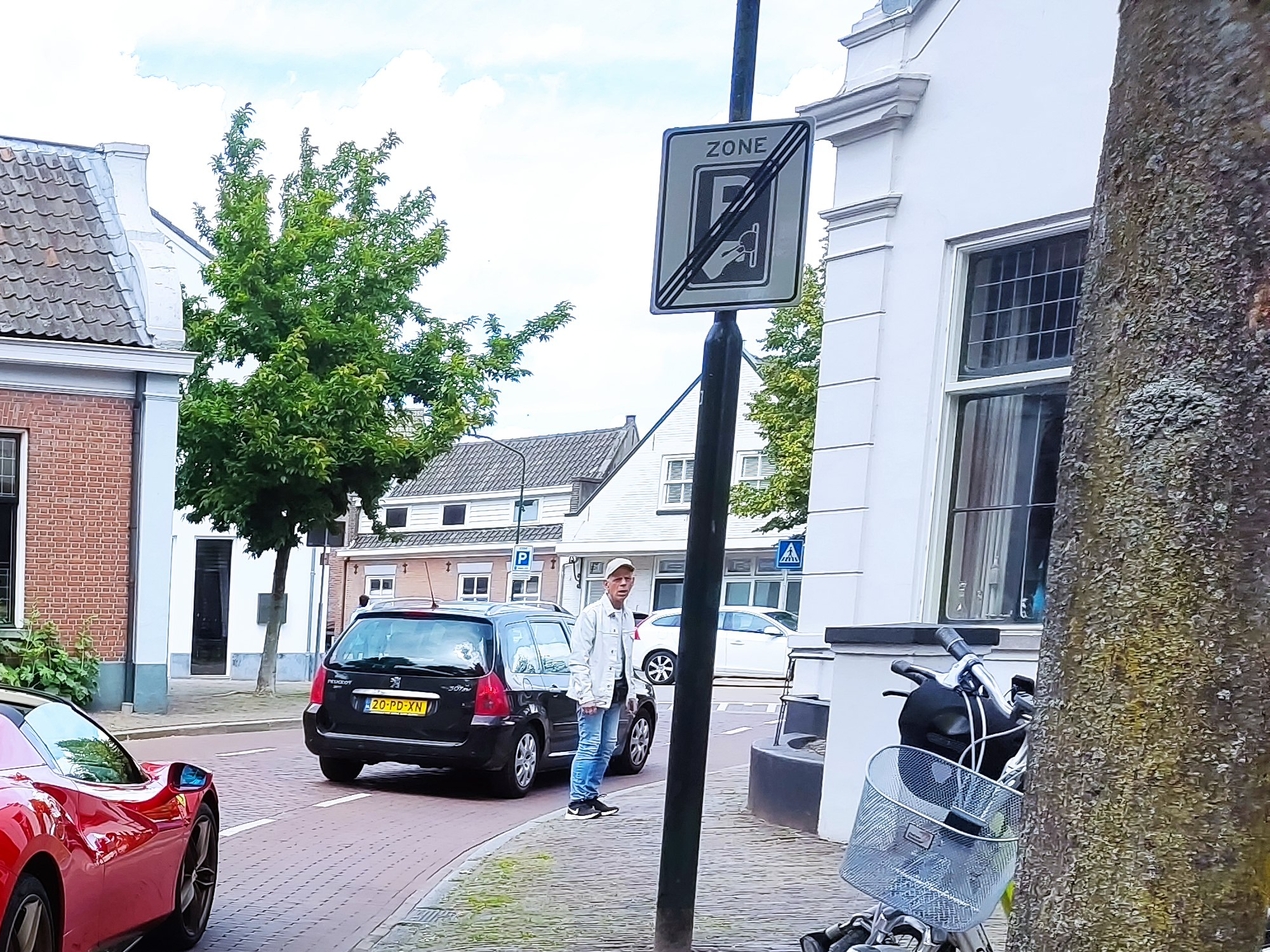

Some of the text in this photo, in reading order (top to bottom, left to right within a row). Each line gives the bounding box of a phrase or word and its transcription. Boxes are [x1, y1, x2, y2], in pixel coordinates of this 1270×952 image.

[706, 136, 768, 158] ZONE
[517, 552, 528, 565] P
[371, 699, 424, 713] 20-PD-XN
